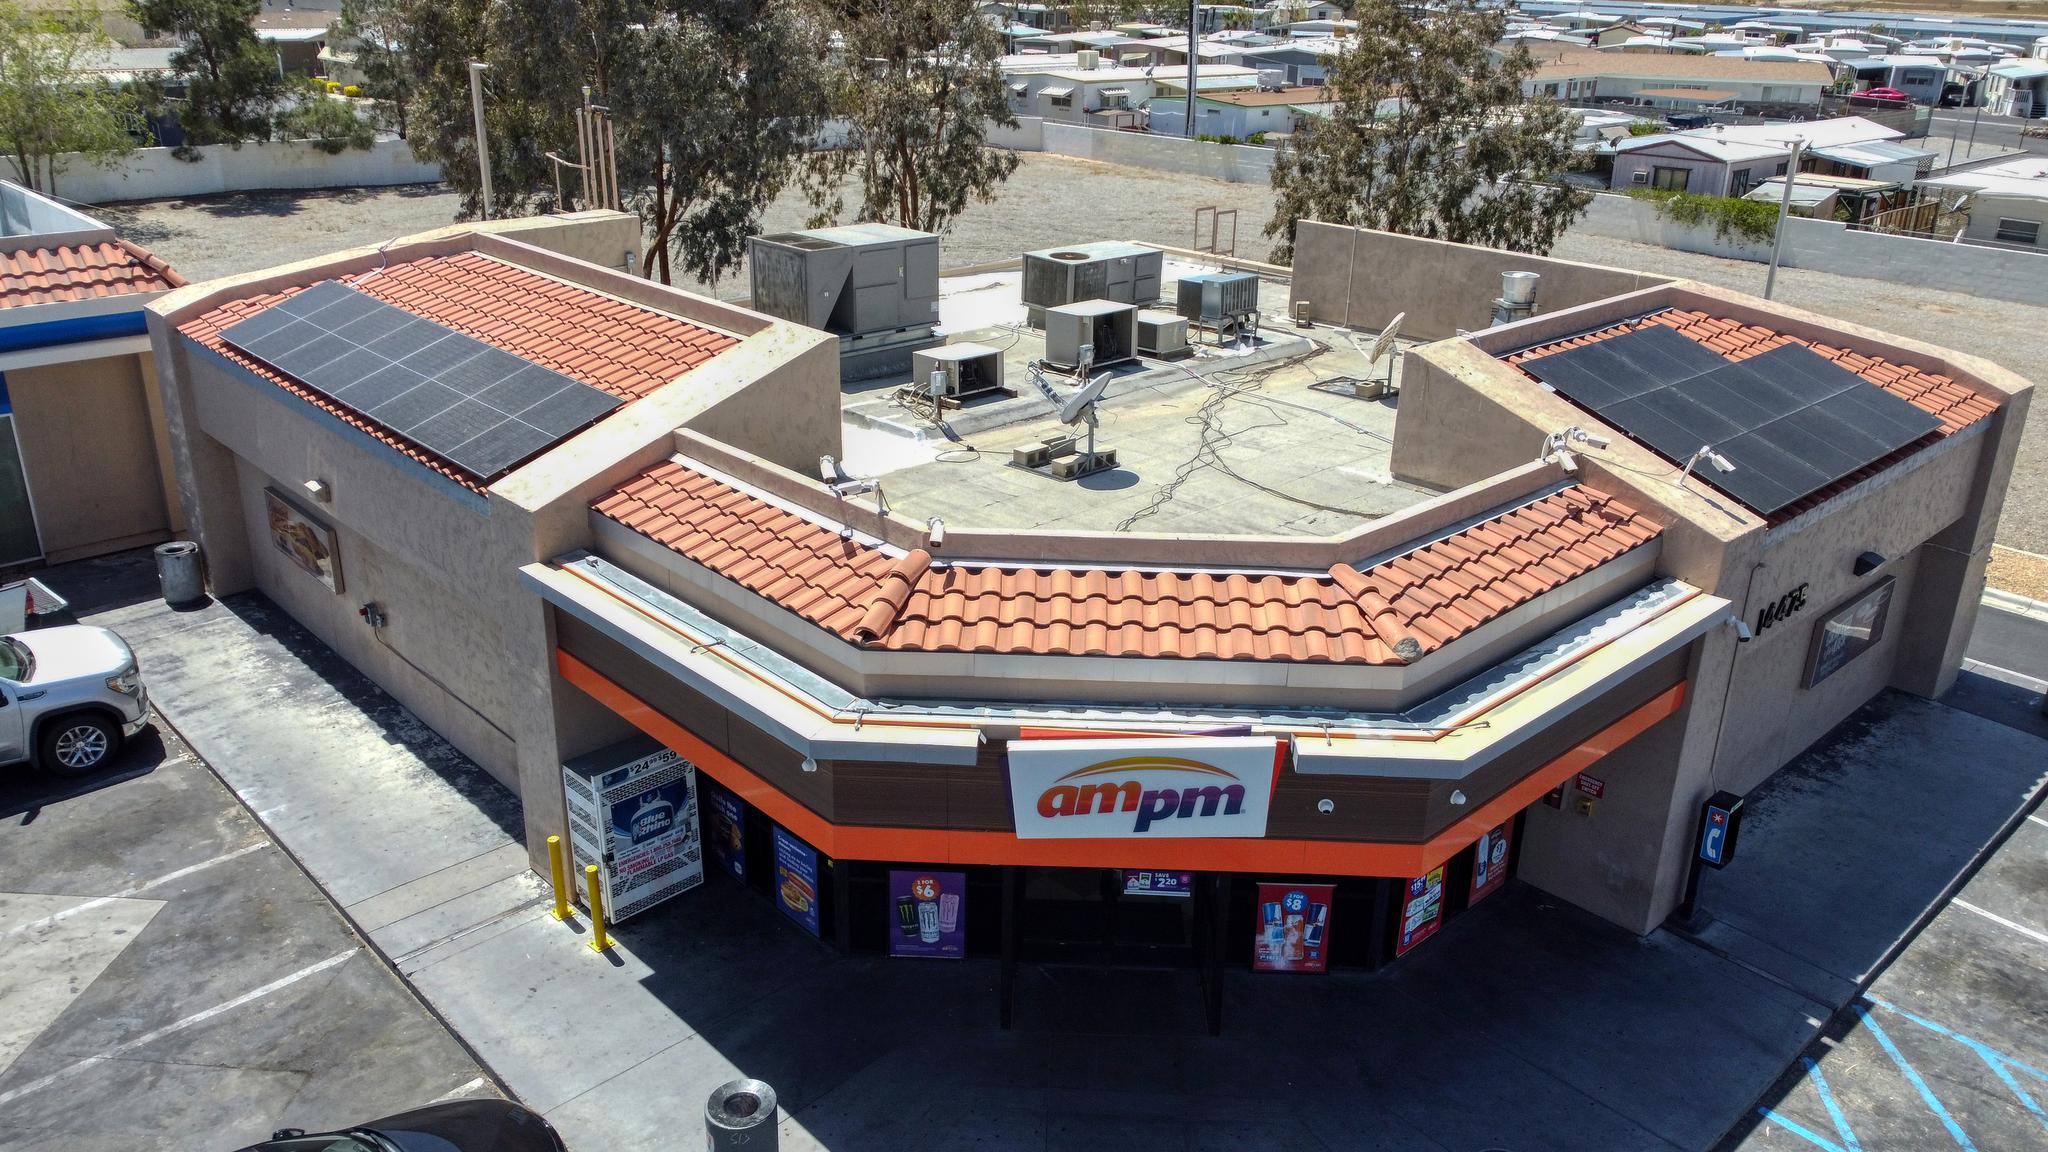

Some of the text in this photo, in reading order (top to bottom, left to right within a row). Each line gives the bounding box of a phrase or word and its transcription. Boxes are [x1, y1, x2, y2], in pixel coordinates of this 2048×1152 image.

[1037, 780, 1246, 833] ampm
[640, 811, 665, 827] Blue
[916, 885, 935, 898] $6
[1286, 899, 1302, 911] $8
